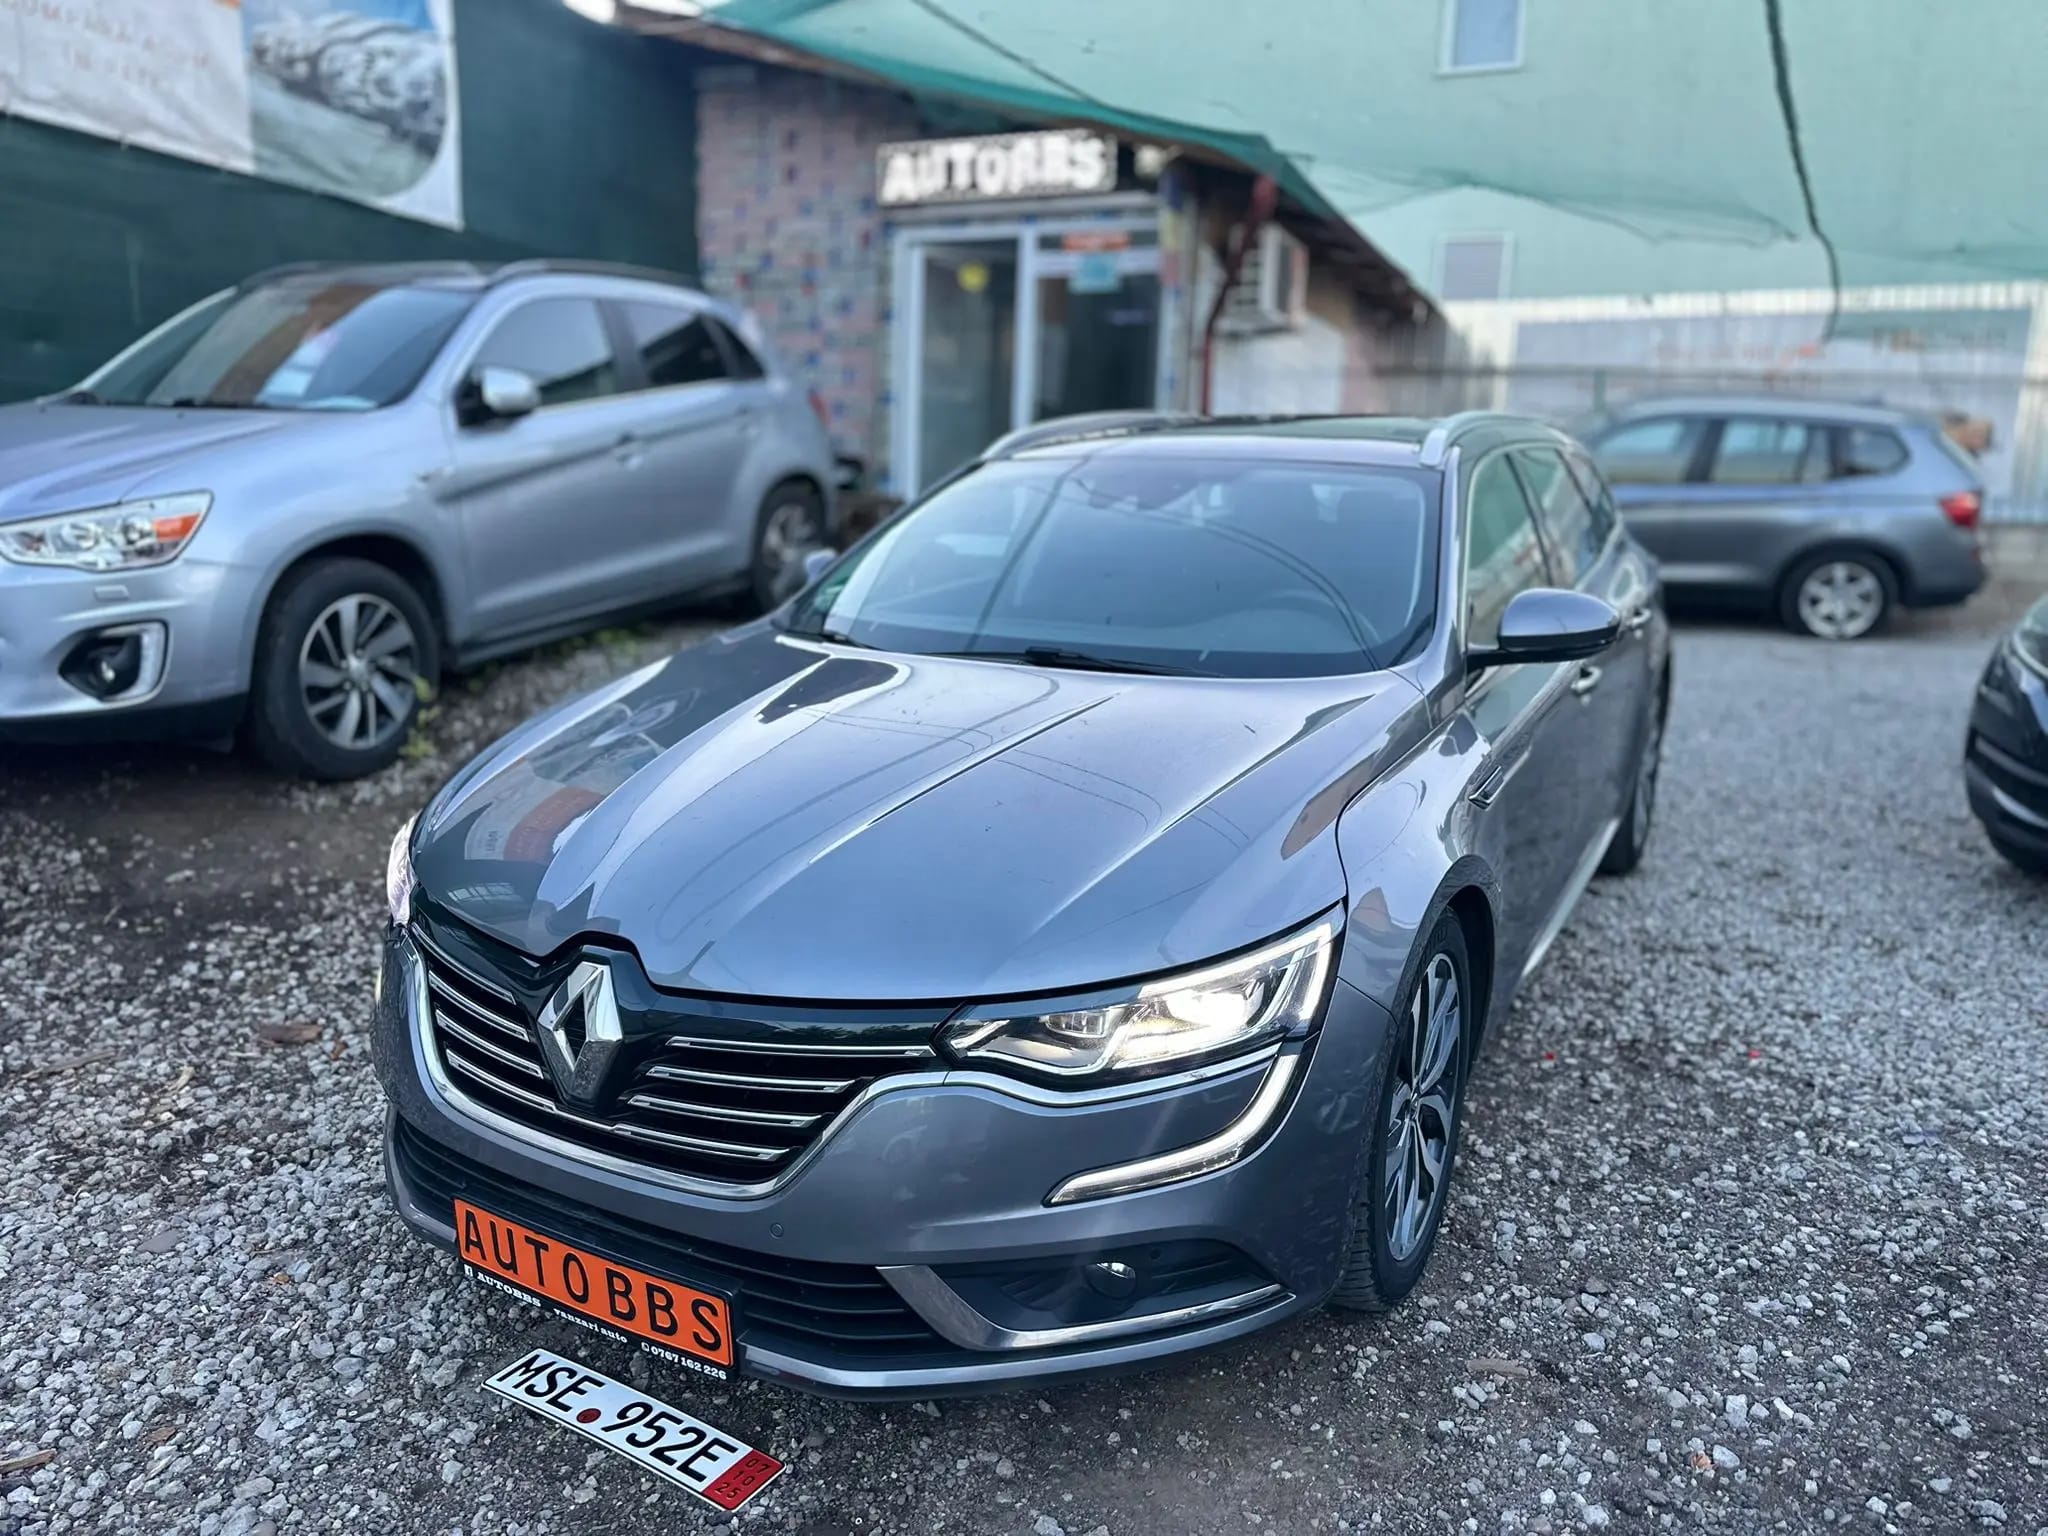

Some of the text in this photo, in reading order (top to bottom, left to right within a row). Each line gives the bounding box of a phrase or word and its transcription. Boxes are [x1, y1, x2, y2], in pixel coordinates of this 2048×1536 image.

[477, 1273, 541, 1307] AUTOBBS
[554, 1309, 598, 1332] vanzari
[600, 1327, 627, 1343] auto
[497, 1354, 738, 1481] MSE 952E
